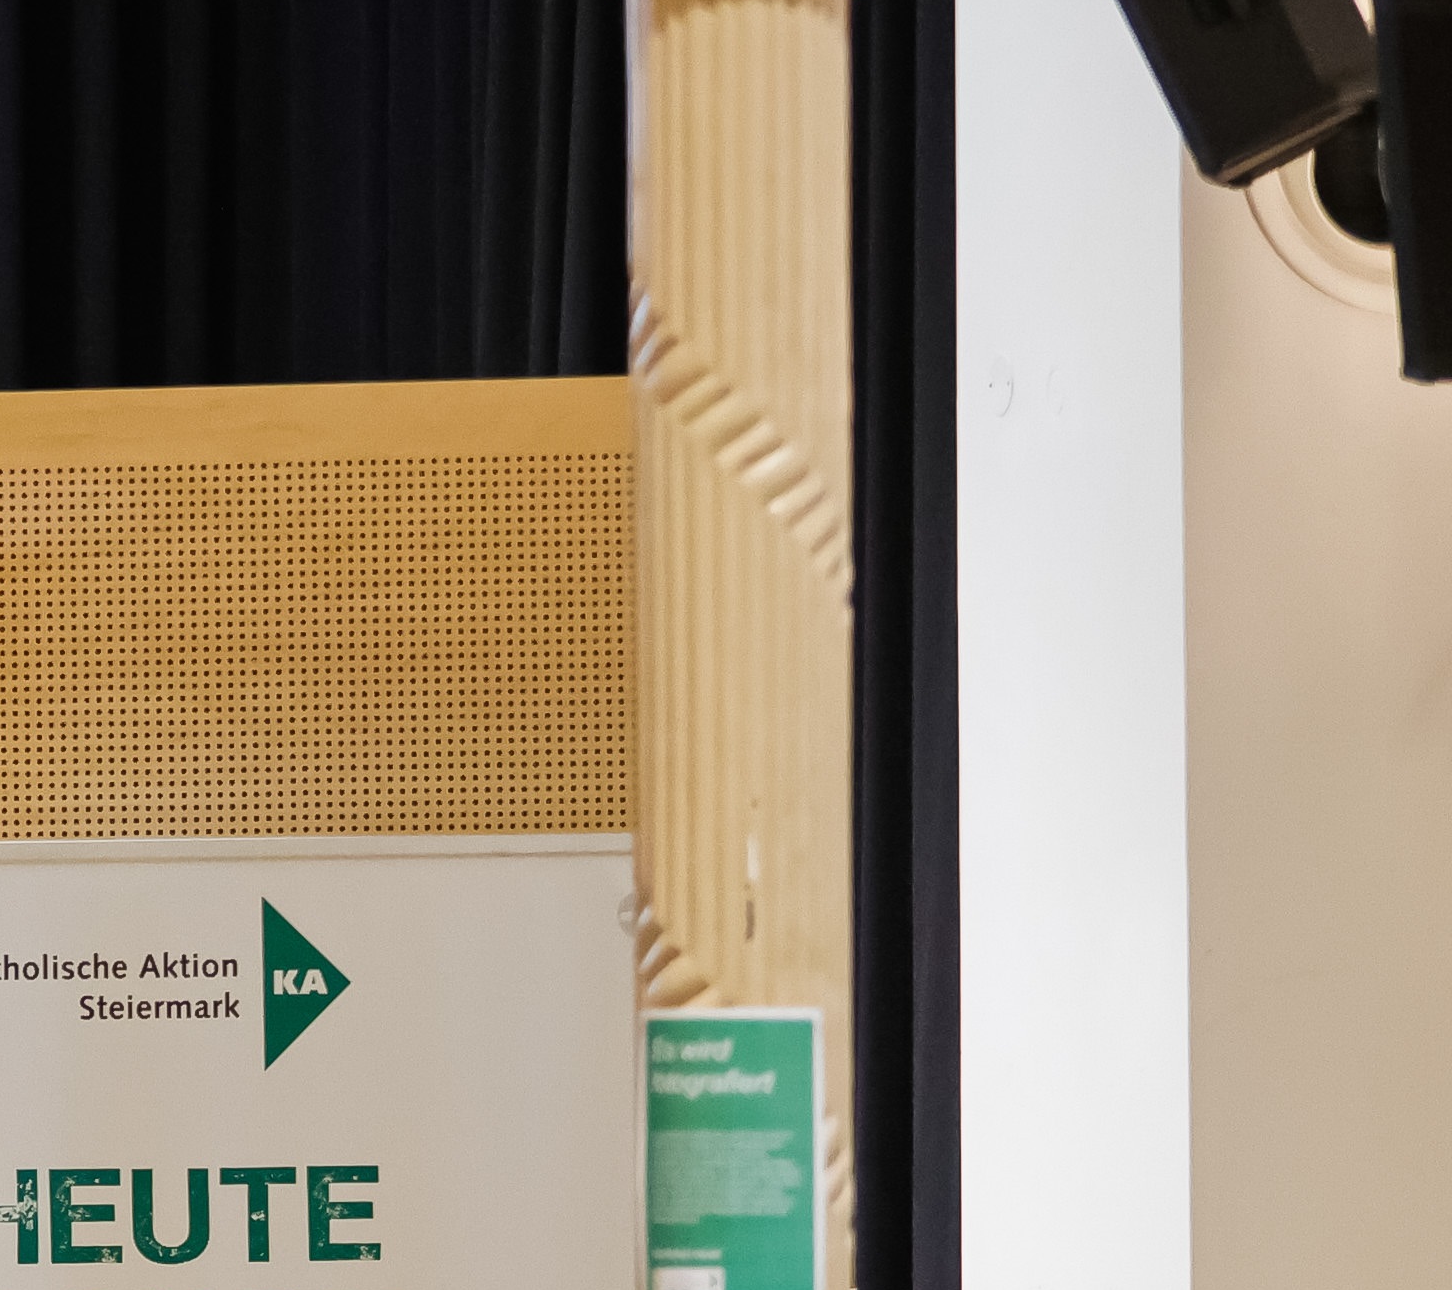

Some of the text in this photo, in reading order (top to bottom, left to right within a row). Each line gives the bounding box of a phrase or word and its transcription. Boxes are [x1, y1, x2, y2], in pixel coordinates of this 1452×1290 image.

[139, 952, 237, 978] Aktion
[274, 969, 327, 994] KA
[80, 992, 239, 1020] Steiermark
